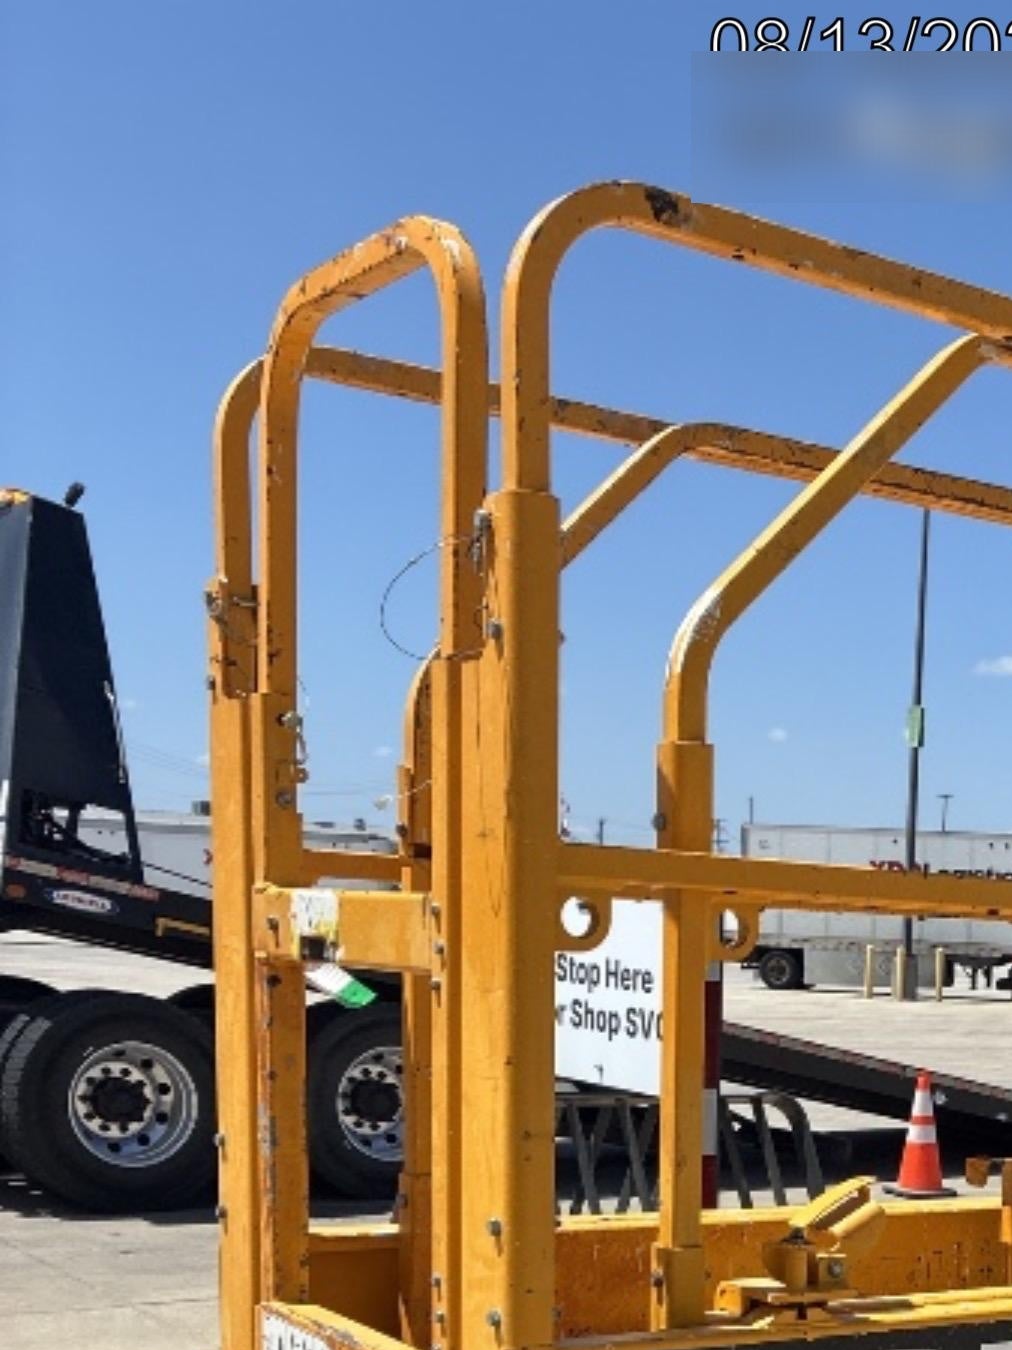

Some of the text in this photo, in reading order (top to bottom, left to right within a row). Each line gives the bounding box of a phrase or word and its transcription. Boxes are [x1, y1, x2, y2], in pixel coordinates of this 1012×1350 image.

[556, 953, 654, 993] Stop Here
[570, 998, 621, 1042] Shop
